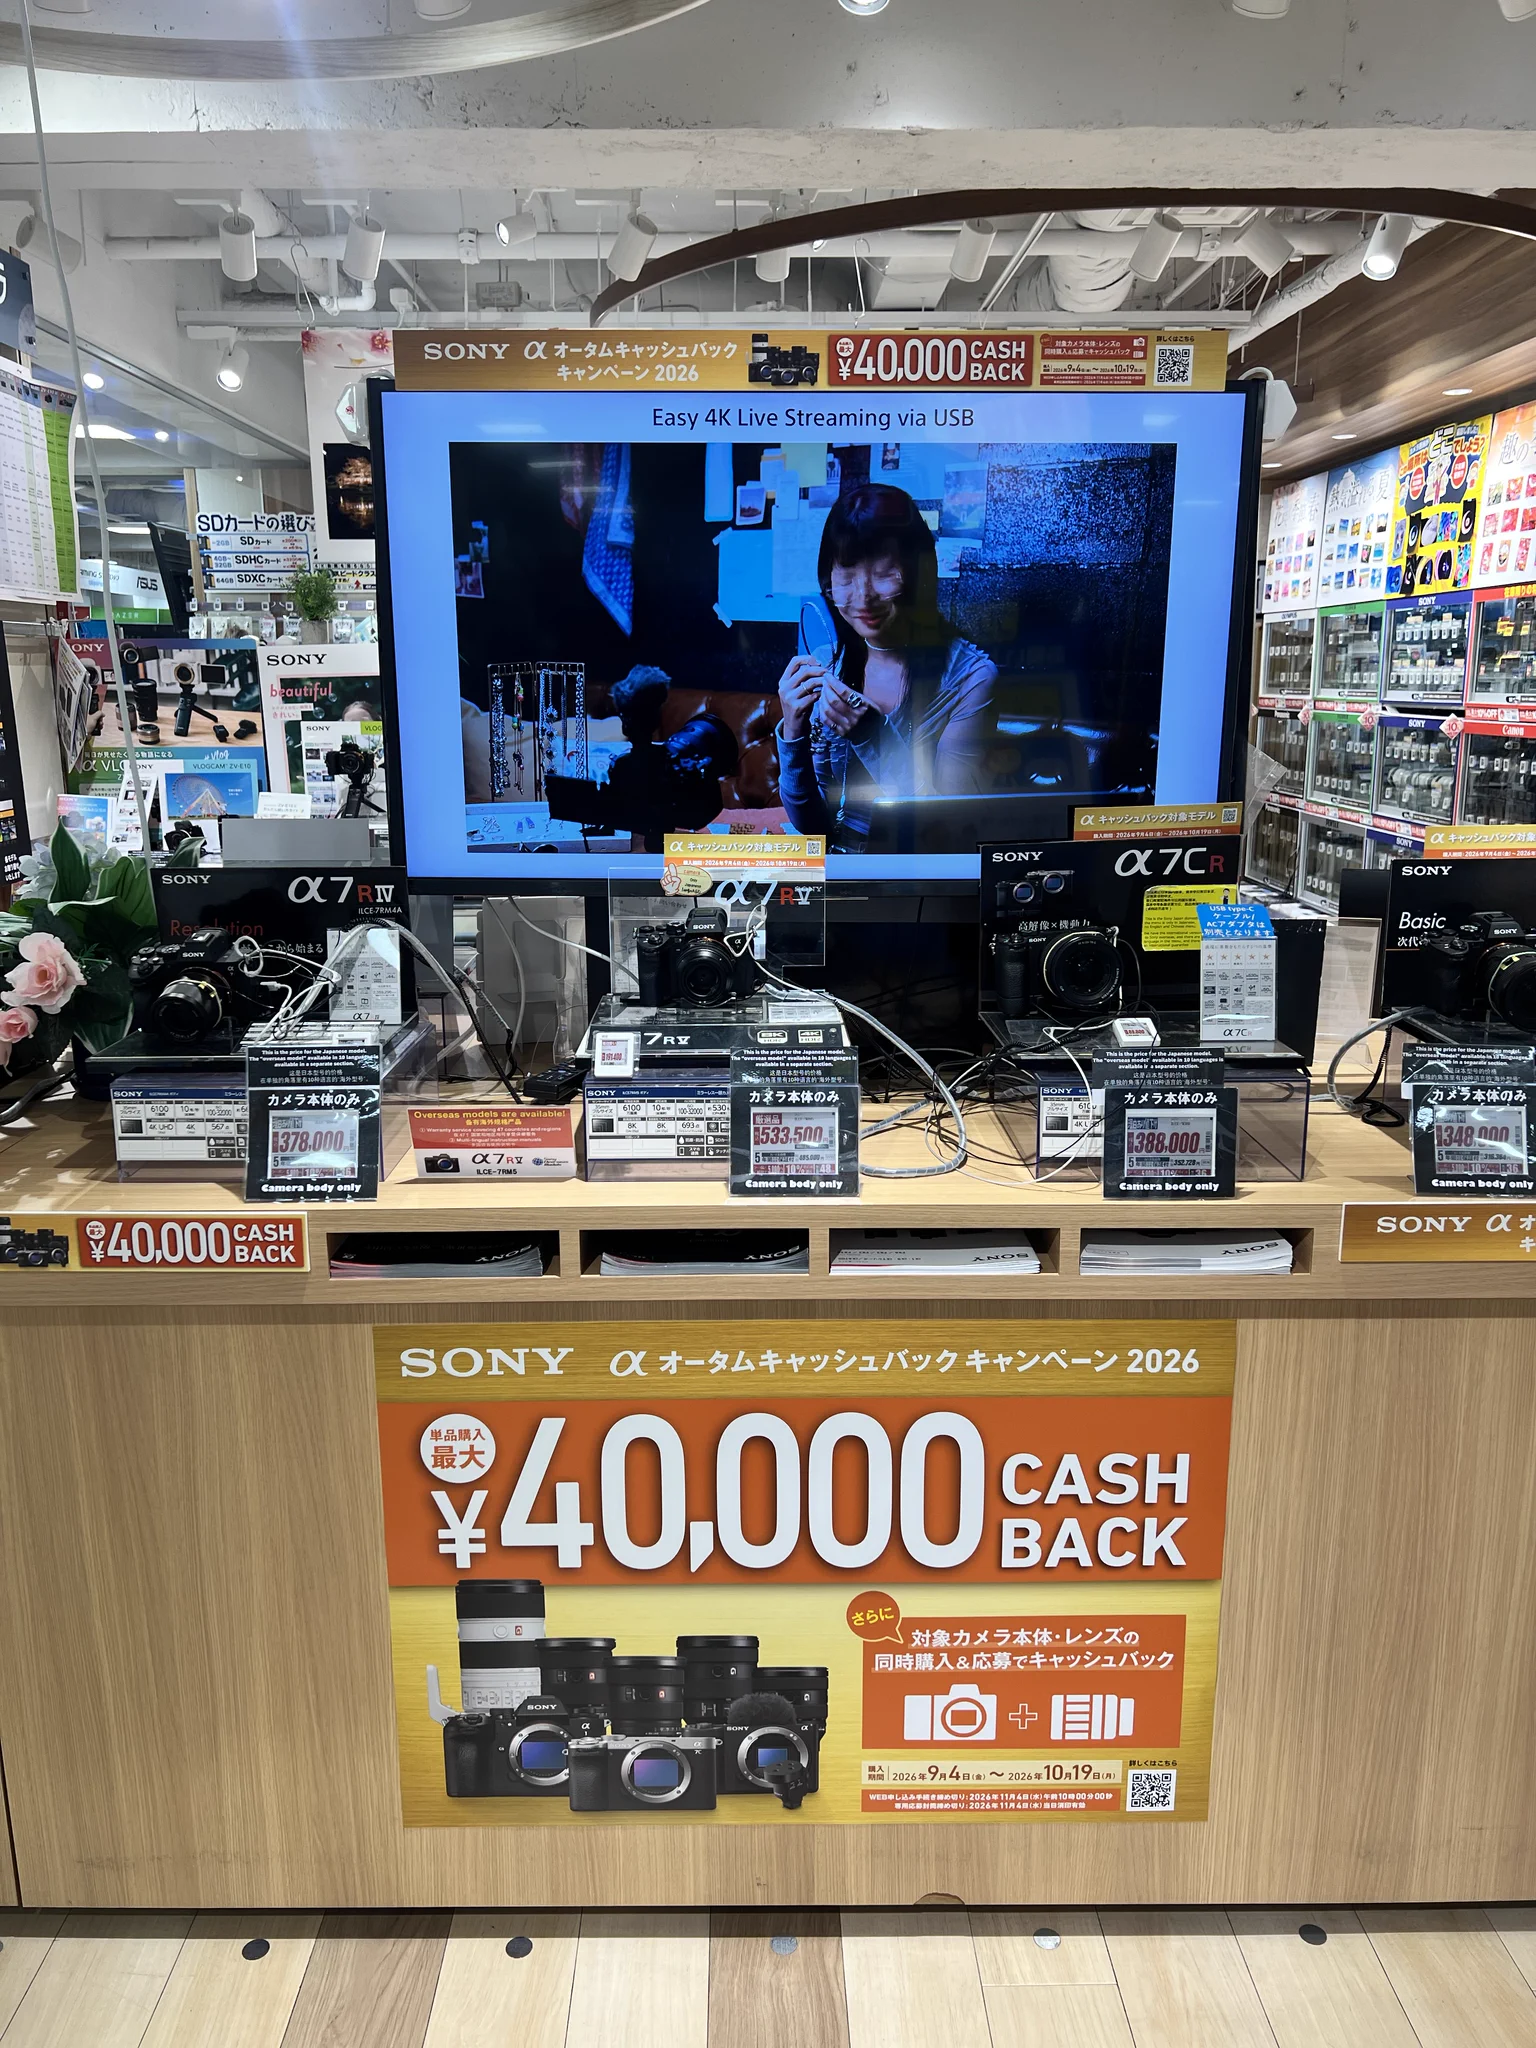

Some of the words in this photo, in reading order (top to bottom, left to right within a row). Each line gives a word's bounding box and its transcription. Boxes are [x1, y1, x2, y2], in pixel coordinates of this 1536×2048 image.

[424, 342, 510, 360] SONY
[524, 340, 548, 360] α
[554, 341, 738, 359] オータムキャッシュバック
[969, 341, 1026, 360] CASH
[837, 338, 967, 383] ¥40,000
[557, 365, 650, 382] キャンペーン
[655, 364, 700, 382] 2026
[969, 363, 1026, 382] BACK
[652, 408, 699, 430] Easy
[705, 408, 732, 427] 4K
[737, 407, 778, 427] Live
[784, 408, 891, 431] Streaming
[897, 408, 927, 427] via
[934, 408, 975, 427] USB
[240, 536, 272, 546] SDカード
[235, 555, 281, 565] SDHCカード
[136, 576, 158, 591] ASUS
[237, 574, 283, 584] SDXCカード
[1418, 596, 1436, 605] SONY
[266, 653, 327, 667] SONY
[269, 681, 333, 702] beautiful
[1409, 719, 1425, 728] SONY
[1502, 724, 1525, 736] Canon
[1080, 814, 1095, 826] α
[1098, 811, 1216, 824] キャッシュバック対象モデル
[1396, 837, 1413, 848] SONY
[1430, 832, 1445, 844] α
[670, 840, 683, 852] α
[687, 841, 801, 853] キャッシュバック対象モデル
[992, 851, 1044, 863] SONY
[1401, 865, 1453, 877] SONY
[162, 874, 211, 885] SONY
[358, 906, 403, 915] ILCE-7RM4A
[1227, 905, 1255, 913] type-C
[692, 923, 716, 931] SONY
[1206, 921, 1266, 929] ACアダプタは
[1398, 911, 1447, 930] Basic
[268, 1093, 361, 1108] カメラ本体のみ
[749, 1090, 840, 1104] カメラ本体のみ
[1124, 1092, 1218, 1105] カメラ本体のみ
[1432, 1089, 1527, 1102] カメラ本体のみ
[150, 1105, 169, 1113] 6100
[414, 1111, 460, 1119] Overseas
[463, 1110, 499, 1119] models
[519, 1110, 566, 1118] available!
[622, 1104, 641, 1112] 6100
[261, 1184, 304, 1192] Camera
[306, 1183, 334, 1193] body
[337, 1183, 361, 1192] only
[745, 1180, 787, 1188] Camera
[789, 1180, 817, 1189] body
[819, 1180, 843, 1189] only
[1119, 1182, 1163, 1190] Camera
[1164, 1182, 1193, 1192] body
[1194, 1182, 1220, 1192] only
[1431, 1179, 1476, 1188] Camera
[1477, 1179, 1507, 1189] body
[1509, 1180, 1534, 1190] only
[1376, 1216, 1472, 1234] SONY
[1486, 1213, 1512, 1232] α
[233, 1223, 295, 1242] CASH
[89, 1221, 231, 1264] ¥40,000
[1221, 1241, 1279, 1256] SONY
[234, 1245, 296, 1263] BACK
[475, 1244, 533, 1262] SONY
[743, 1244, 800, 1261] SONY
[972, 1252, 1029, 1262] SONY
[400, 1347, 574, 1378] SONY
[609, 1349, 649, 1378] α
[658, 1347, 958, 1375] オータムキャッシュバック
[965, 1347, 1118, 1375] キャンペーン
[1126, 1347, 1200, 1375] 2026
[429, 1428, 486, 1443] 単品購入
[431, 1444, 486, 1471] 最大
[1001, 1452, 1191, 1506] CASH
[430, 1411, 986, 1574] ¥40,000
[1001, 1516, 1189, 1569] BACK
[851, 1606, 895, 1627] さらに
[911, 1627, 1140, 1648] 対象カメラ本体・レンズの
[874, 1650, 1175, 1671] 同時購入&応募でキャッシュバック
[526, 1702, 557, 1712] SONY
[867, 1765, 885, 1773] 購入
[1129, 1758, 1178, 1767] 詳しくはこちら
[867, 1773, 885, 1782] 期間
